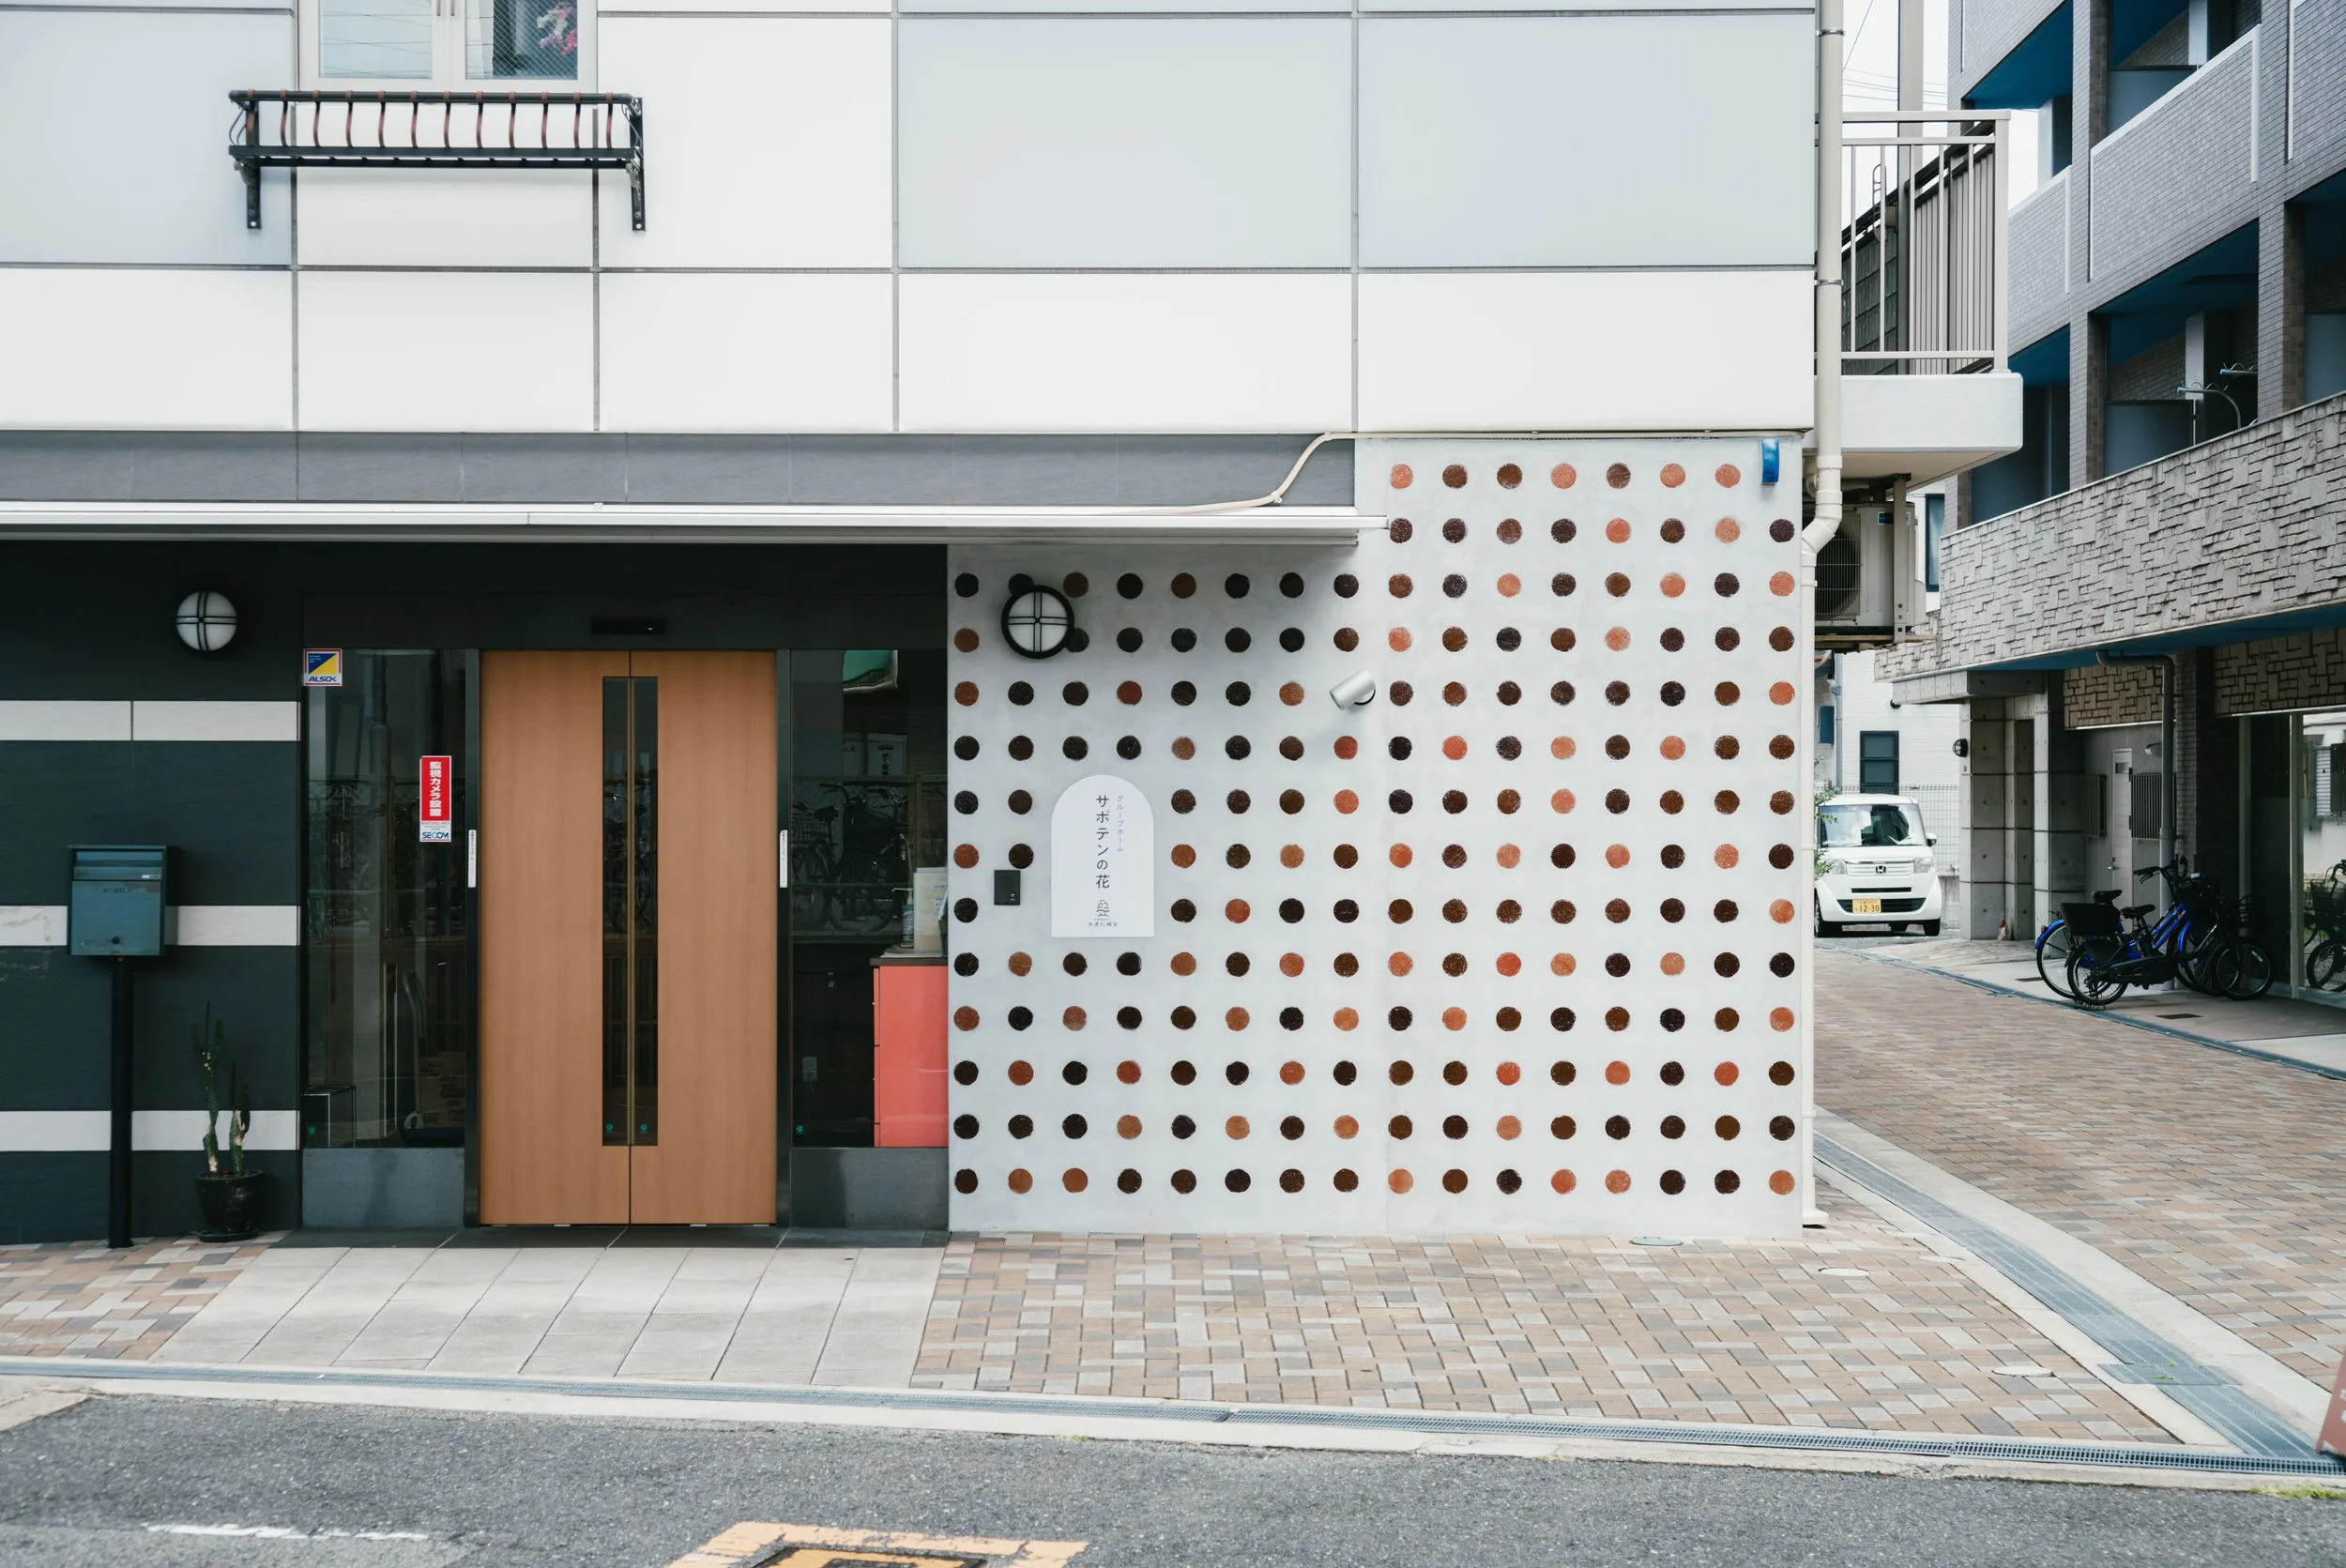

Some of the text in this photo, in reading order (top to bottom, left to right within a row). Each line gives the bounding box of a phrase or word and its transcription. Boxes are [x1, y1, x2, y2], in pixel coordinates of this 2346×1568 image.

[429, 761, 442, 817] 監視カメラ設置
[1095, 794, 1110, 890] サボテンの花
[1859, 905, 1881, 913] 12-30
